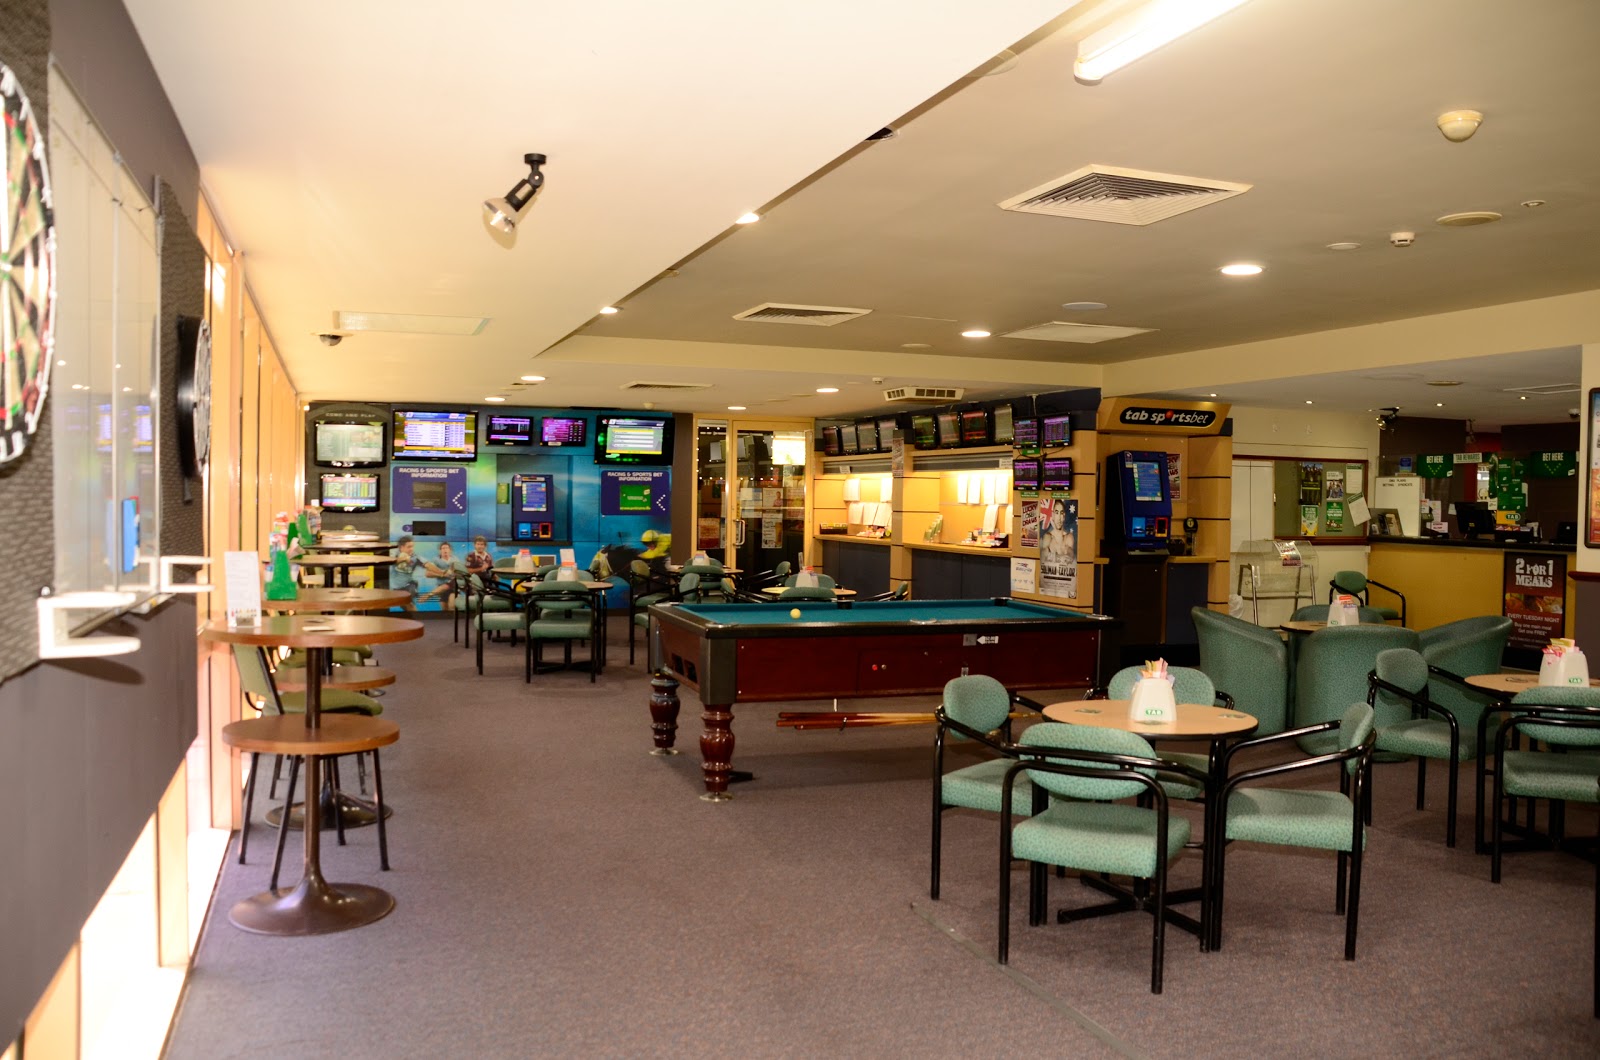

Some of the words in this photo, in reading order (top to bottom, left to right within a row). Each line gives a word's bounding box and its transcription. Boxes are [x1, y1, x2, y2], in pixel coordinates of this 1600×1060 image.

[1125, 410, 1148, 421] tab
[1542, 453, 1550, 462] BET
[1552, 452, 1564, 461] HERE
[1022, 504, 1038, 514] LUCKY
[1516, 558, 1525, 574] 2
[1526, 564, 1546, 576] FOR
[1547, 560, 1554, 576] 1
[1516, 574, 1553, 588] MEALS
